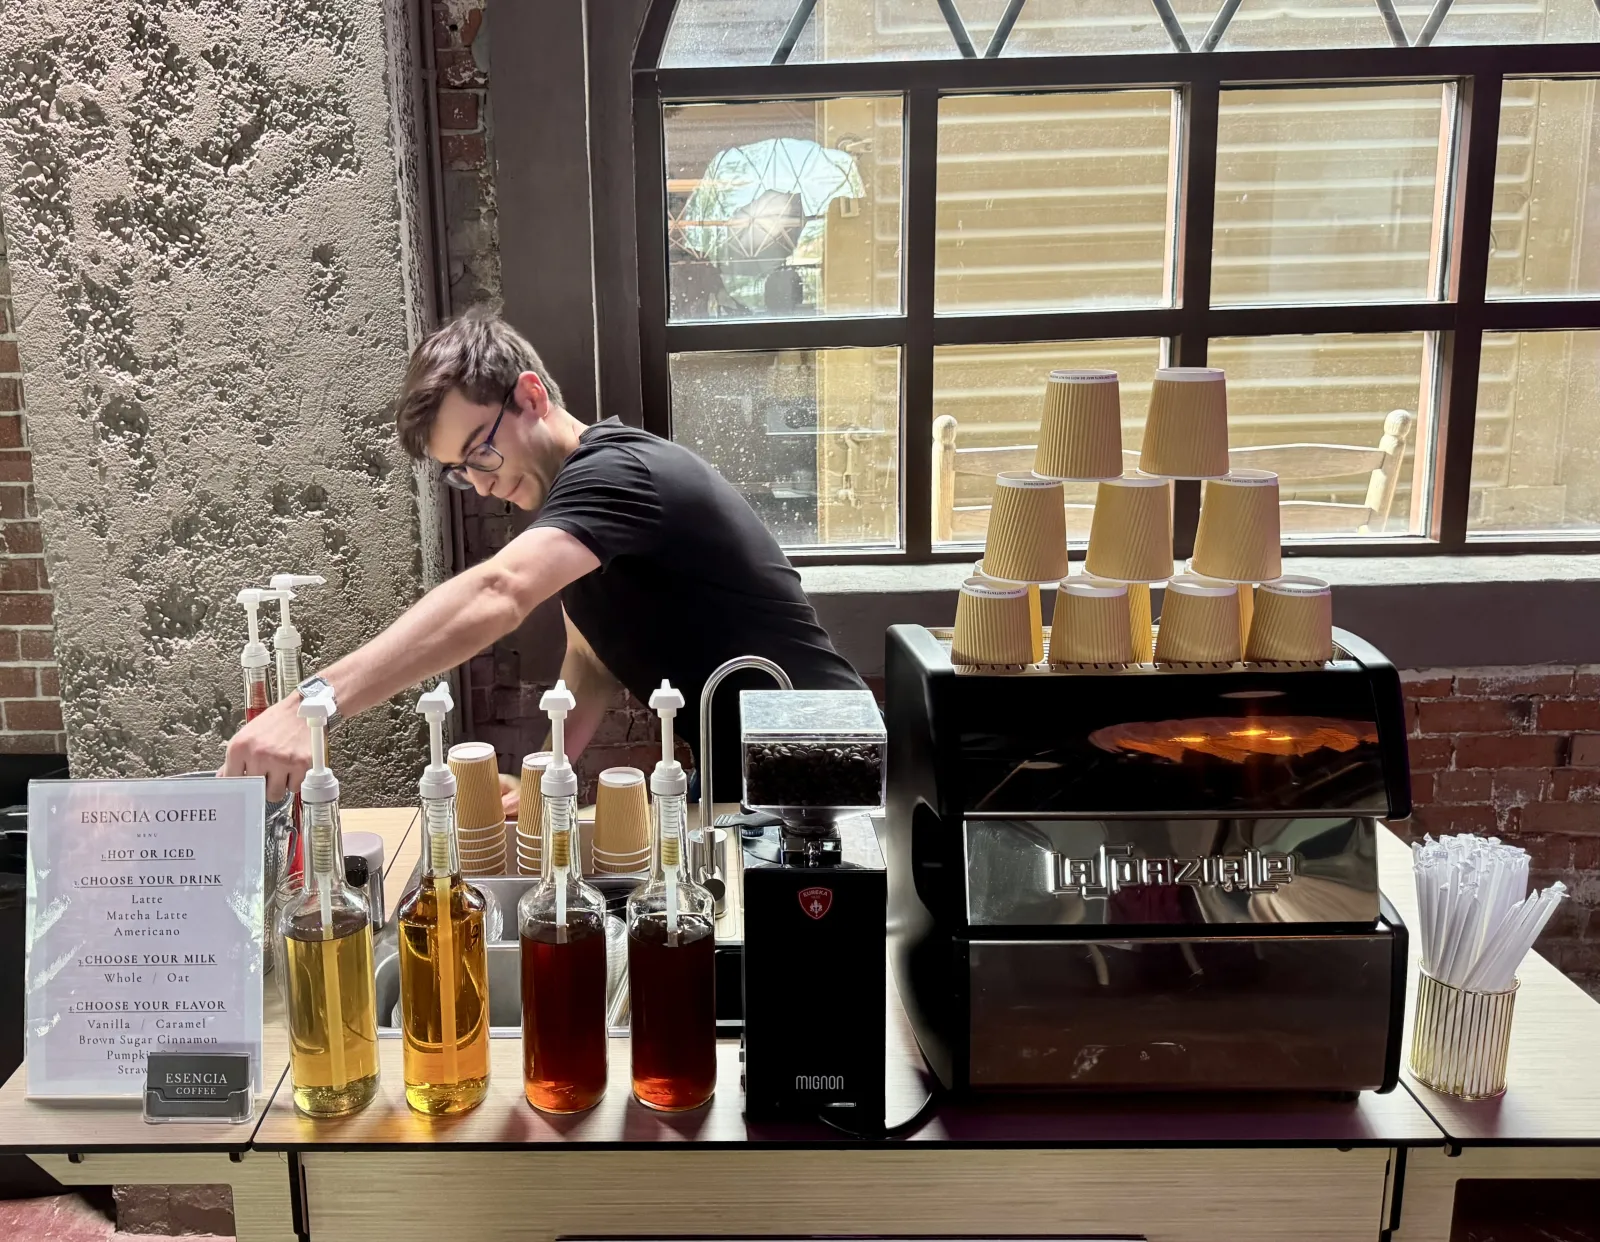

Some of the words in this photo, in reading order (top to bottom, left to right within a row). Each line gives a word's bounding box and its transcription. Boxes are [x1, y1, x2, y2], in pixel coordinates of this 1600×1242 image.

[80, 811, 150, 824] ESENCIA
[155, 808, 217, 823] COFFEE
[140, 849, 158, 859] OR
[164, 848, 194, 859] ICED
[139, 875, 175, 886] YOUR
[180, 874, 222, 885] DRINK
[131, 894, 163, 904] Latte
[106, 910, 151, 921] Matcha
[156, 910, 188, 920] Latte
[114, 927, 180, 937] Americano
[143, 954, 179, 964] YOUR
[184, 954, 216, 964] MILK
[104, 972, 142, 983] Whole
[167, 972, 190, 983] Oat
[134, 1001, 170, 1011] YOUR
[175, 1000, 226, 1010] FLAVOR
[87, 1018, 131, 1029] Vanilla
[155, 1018, 206, 1029] Caramel
[79, 1034, 115, 1045] Brown
[119, 1034, 152, 1048] Sugar
[157, 1034, 218, 1045] Cinnamon
[107, 1050, 149, 1062] Pumpki
[118, 1064, 148, 1075] Straw
[165, 1072, 228, 1084] ESENCIA
[175, 1087, 217, 1095] COFFEE
